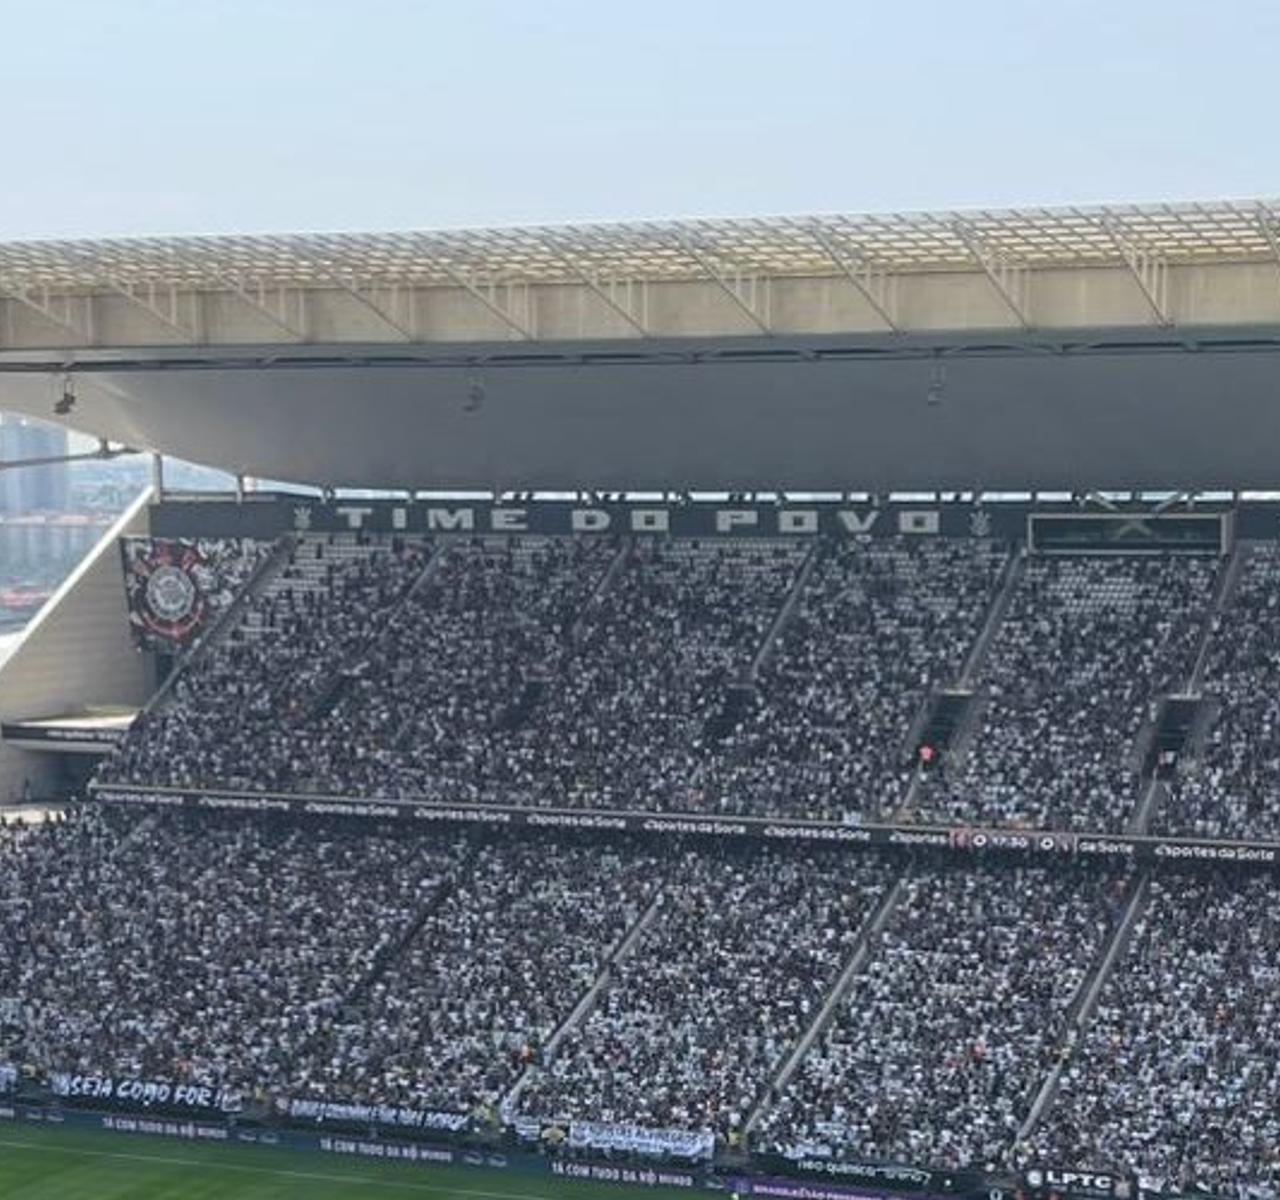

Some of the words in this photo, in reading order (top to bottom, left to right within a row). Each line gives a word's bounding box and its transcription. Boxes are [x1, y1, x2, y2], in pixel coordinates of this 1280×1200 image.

[337, 507, 529, 531] TIME
[573, 509, 669, 532] DO
[718, 510, 939, 535] POVO
[1046, 1171, 1112, 1189] LPTC
